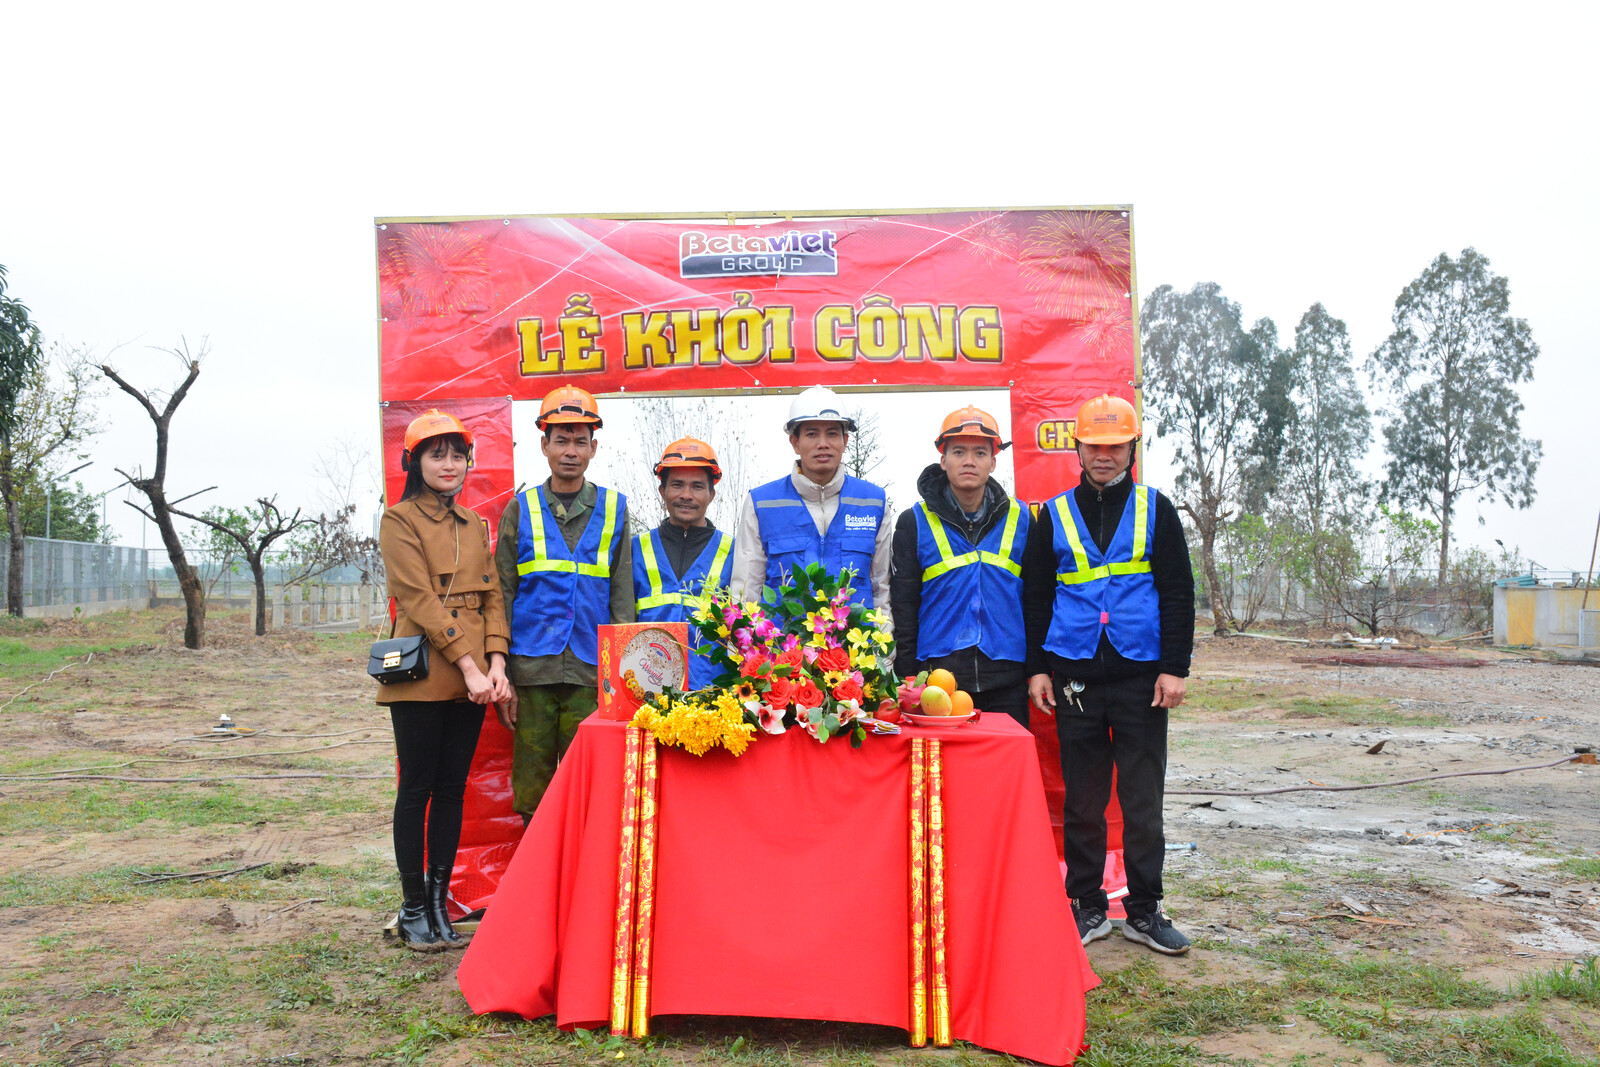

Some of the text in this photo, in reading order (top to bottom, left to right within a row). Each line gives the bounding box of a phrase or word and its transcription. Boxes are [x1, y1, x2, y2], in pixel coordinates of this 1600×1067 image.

[681, 230, 837, 260] Betaviet
[721, 256, 803, 271] GROUP
[517, 291, 1003, 376] LỄ KHỞI CÔNG
[1036, 419, 1077, 453] CH
